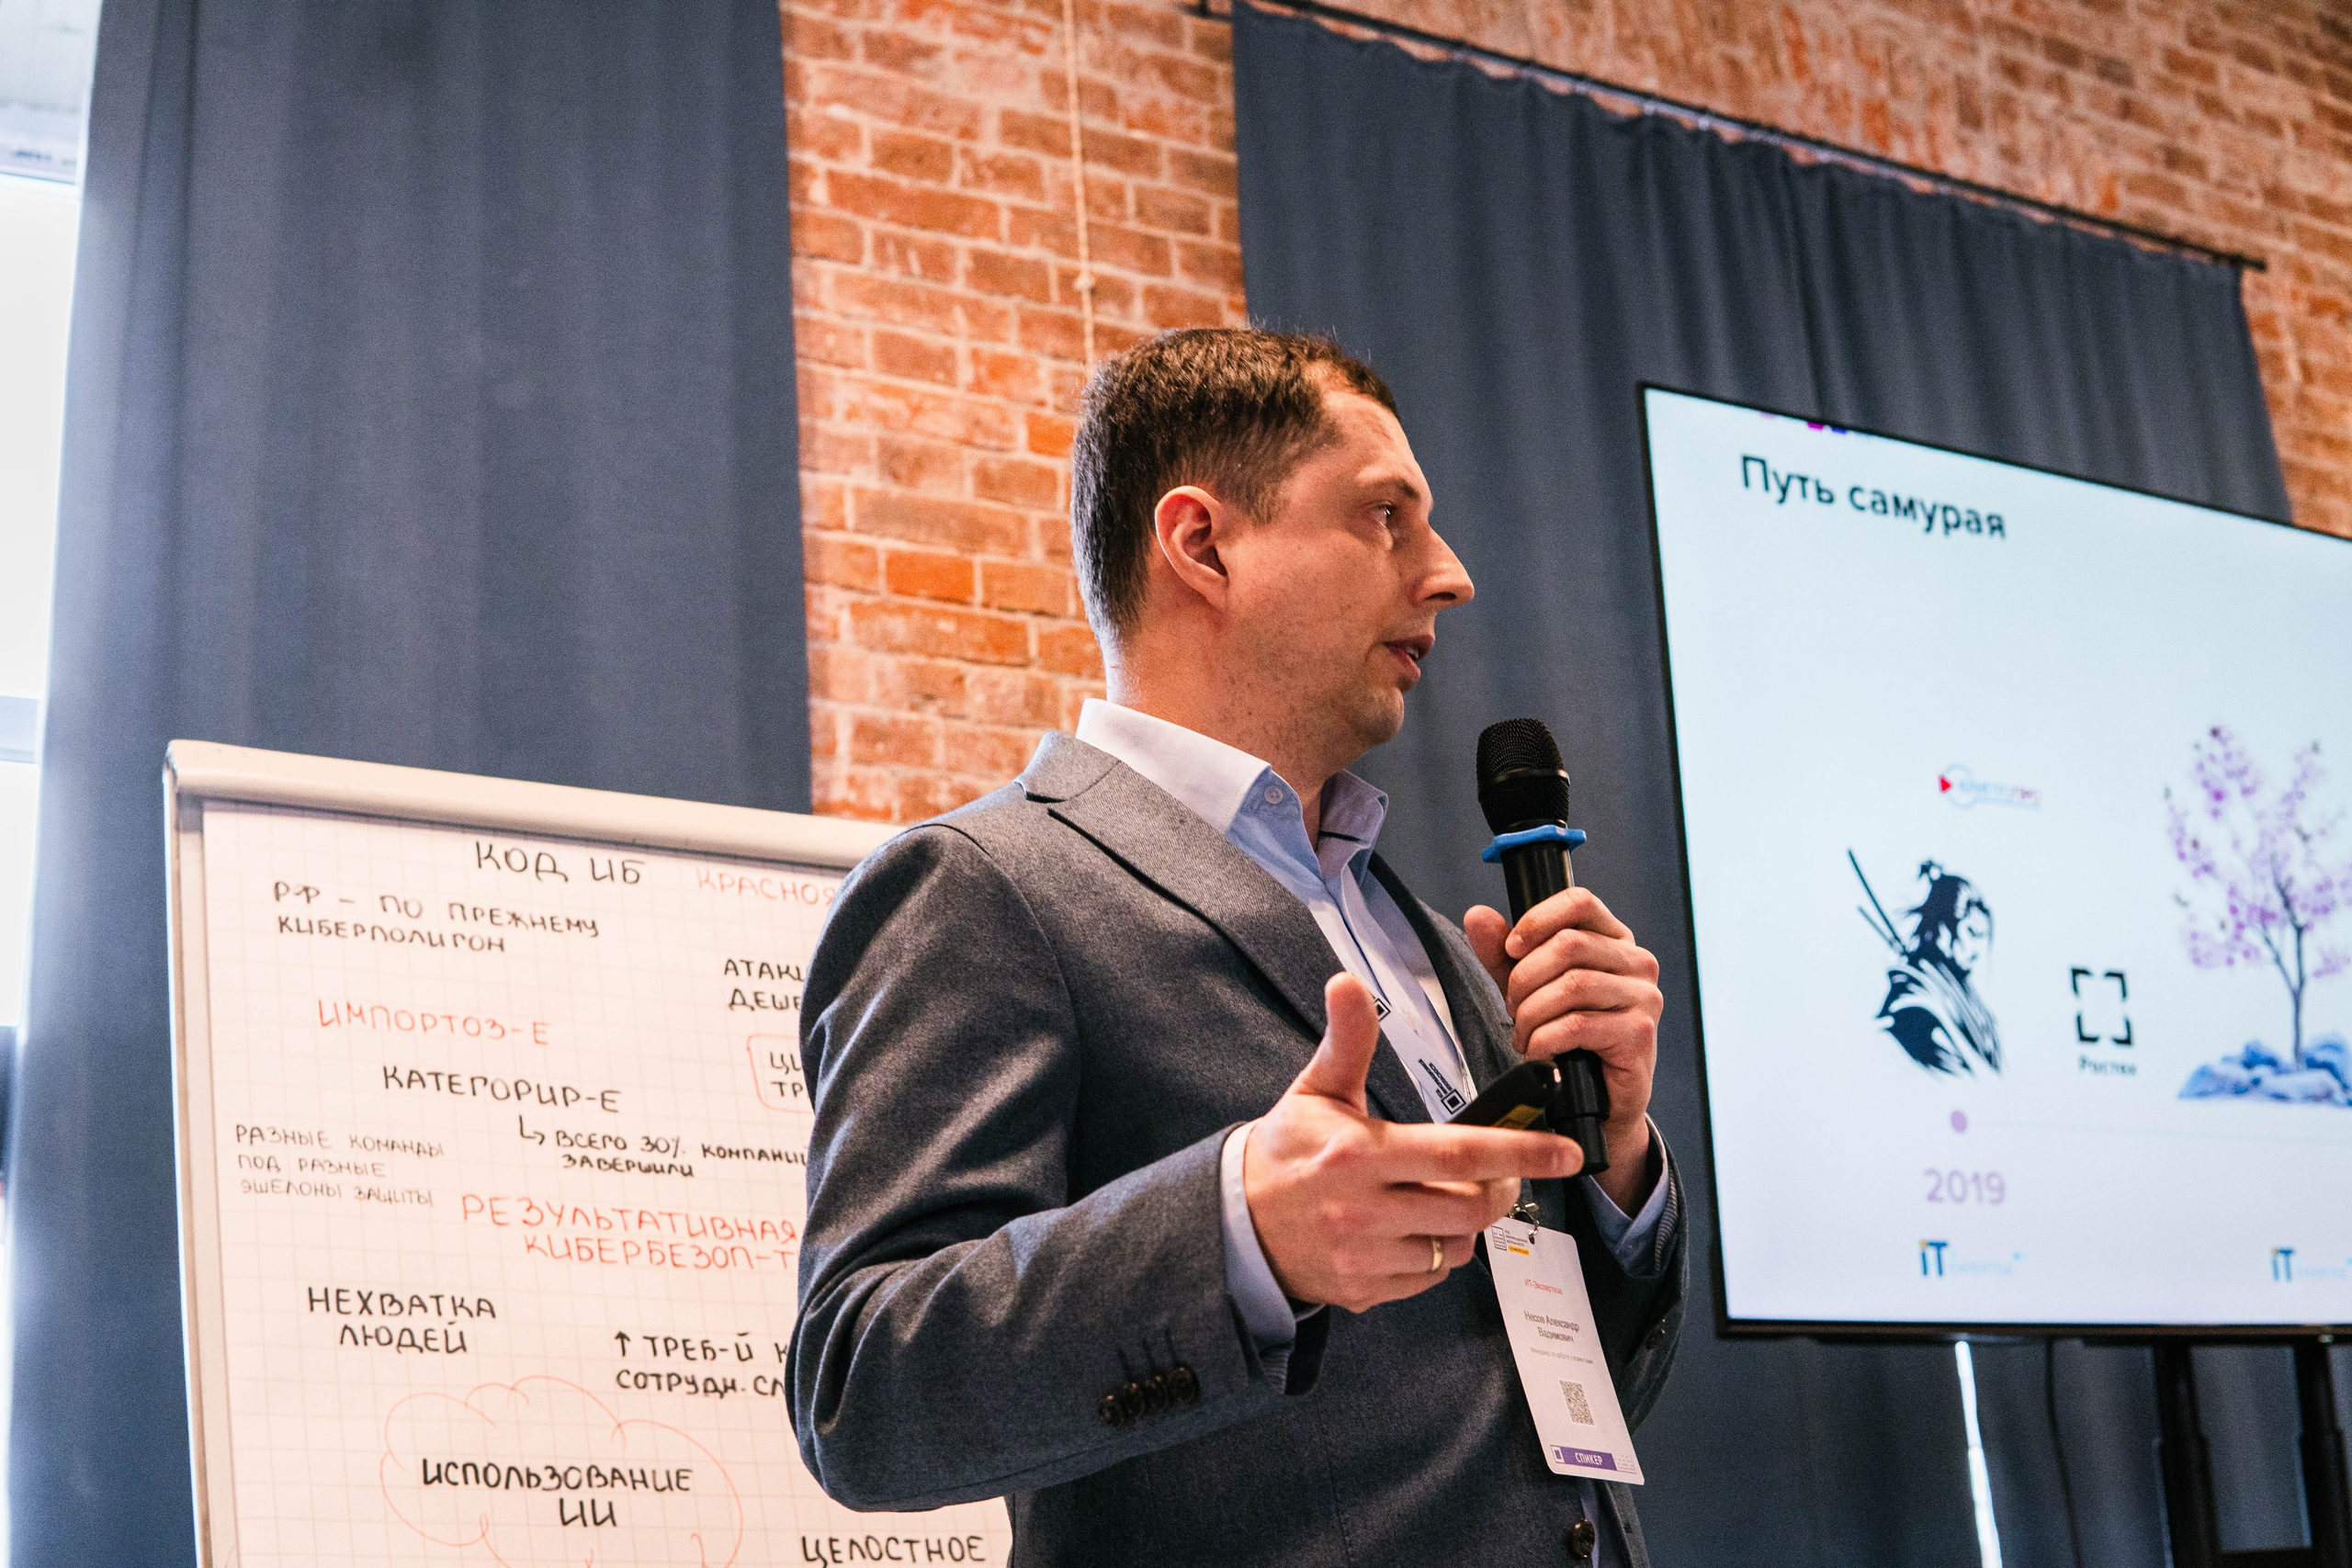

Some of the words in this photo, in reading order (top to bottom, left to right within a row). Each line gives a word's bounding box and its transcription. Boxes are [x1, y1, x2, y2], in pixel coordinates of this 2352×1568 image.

[1742, 455, 1835, 504] Путь
[1849, 485, 2007, 540] самурая
[475, 841, 569, 883] КОД
[591, 857, 646, 885] ИБ
[379, 895, 423, 918] ПО
[448, 903, 599, 938] ПРЕЖНЕМУ
[277, 915, 505, 953] КИБЕРПОЛИГОН
[318, 998, 550, 1045] ИМПОРТОЗ-Е
[383, 1066, 621, 1112] КАТЕГОРИР-Е
[236, 1123, 333, 1148] РАЗНЫЕ
[349, 1134, 445, 1157] КОМАНДЫ
[556, 1130, 628, 1150] ВСЕГО
[238, 1154, 281, 1173] ПОД
[298, 1157, 386, 1178] РАЗНЫЕ
[561, 1154, 695, 1178] ЗАВЕРШИЛИ
[241, 1179, 342, 1198] ЭШЕЛОНЫ
[355, 1186, 434, 1207] ЗАЩИТЫ
[1925, 1168, 2007, 1205] 2019
[461, 1194, 797, 1245] РЕЗУЛЬТАТИВНАЯ
[308, 1286, 497, 1319] НЕХВАТКА
[340, 1321, 468, 1354] ЛЮДЕЙ
[643, 1332, 753, 1362] ТРЕБ-Й
[422, 1458, 694, 1493] ИСПОЛЬЗОВАНИЕ
[1575, 1451, 1603, 1467] СПИКЕР
[559, 1497, 617, 1528] ИИ
[800, 1535, 987, 1568] ЦЕЛОСТНОЕ
